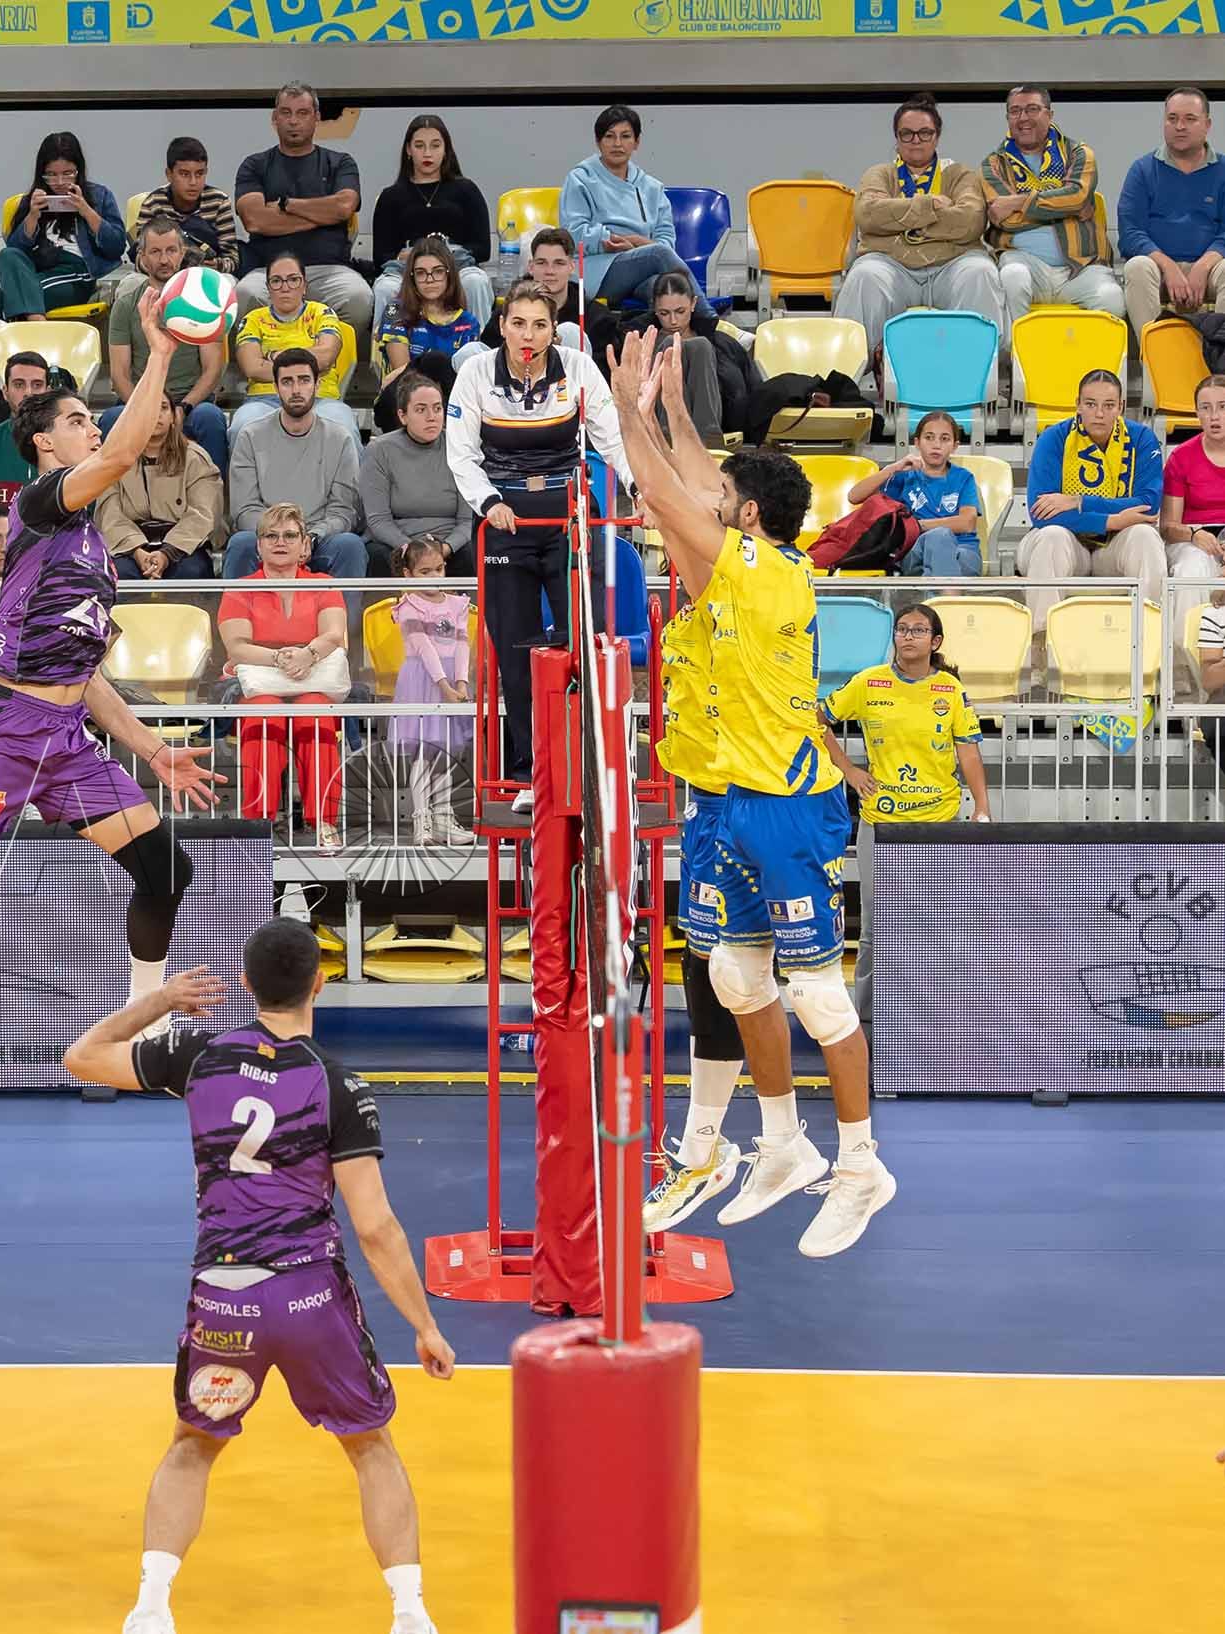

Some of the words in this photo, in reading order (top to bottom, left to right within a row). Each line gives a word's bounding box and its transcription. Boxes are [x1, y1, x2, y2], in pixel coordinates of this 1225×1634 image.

[677, 0, 733, 21] GRAN
[734, 0, 822, 21] CANARIA
[679, 23, 703, 32] CLUB
[705, 23, 718, 32] DE
[720, 23, 781, 32] BALONCESTO
[239, 1062, 279, 1084] RIBAS
[229, 1096, 275, 1175] 2
[288, 1288, 333, 1313] PARQUE
